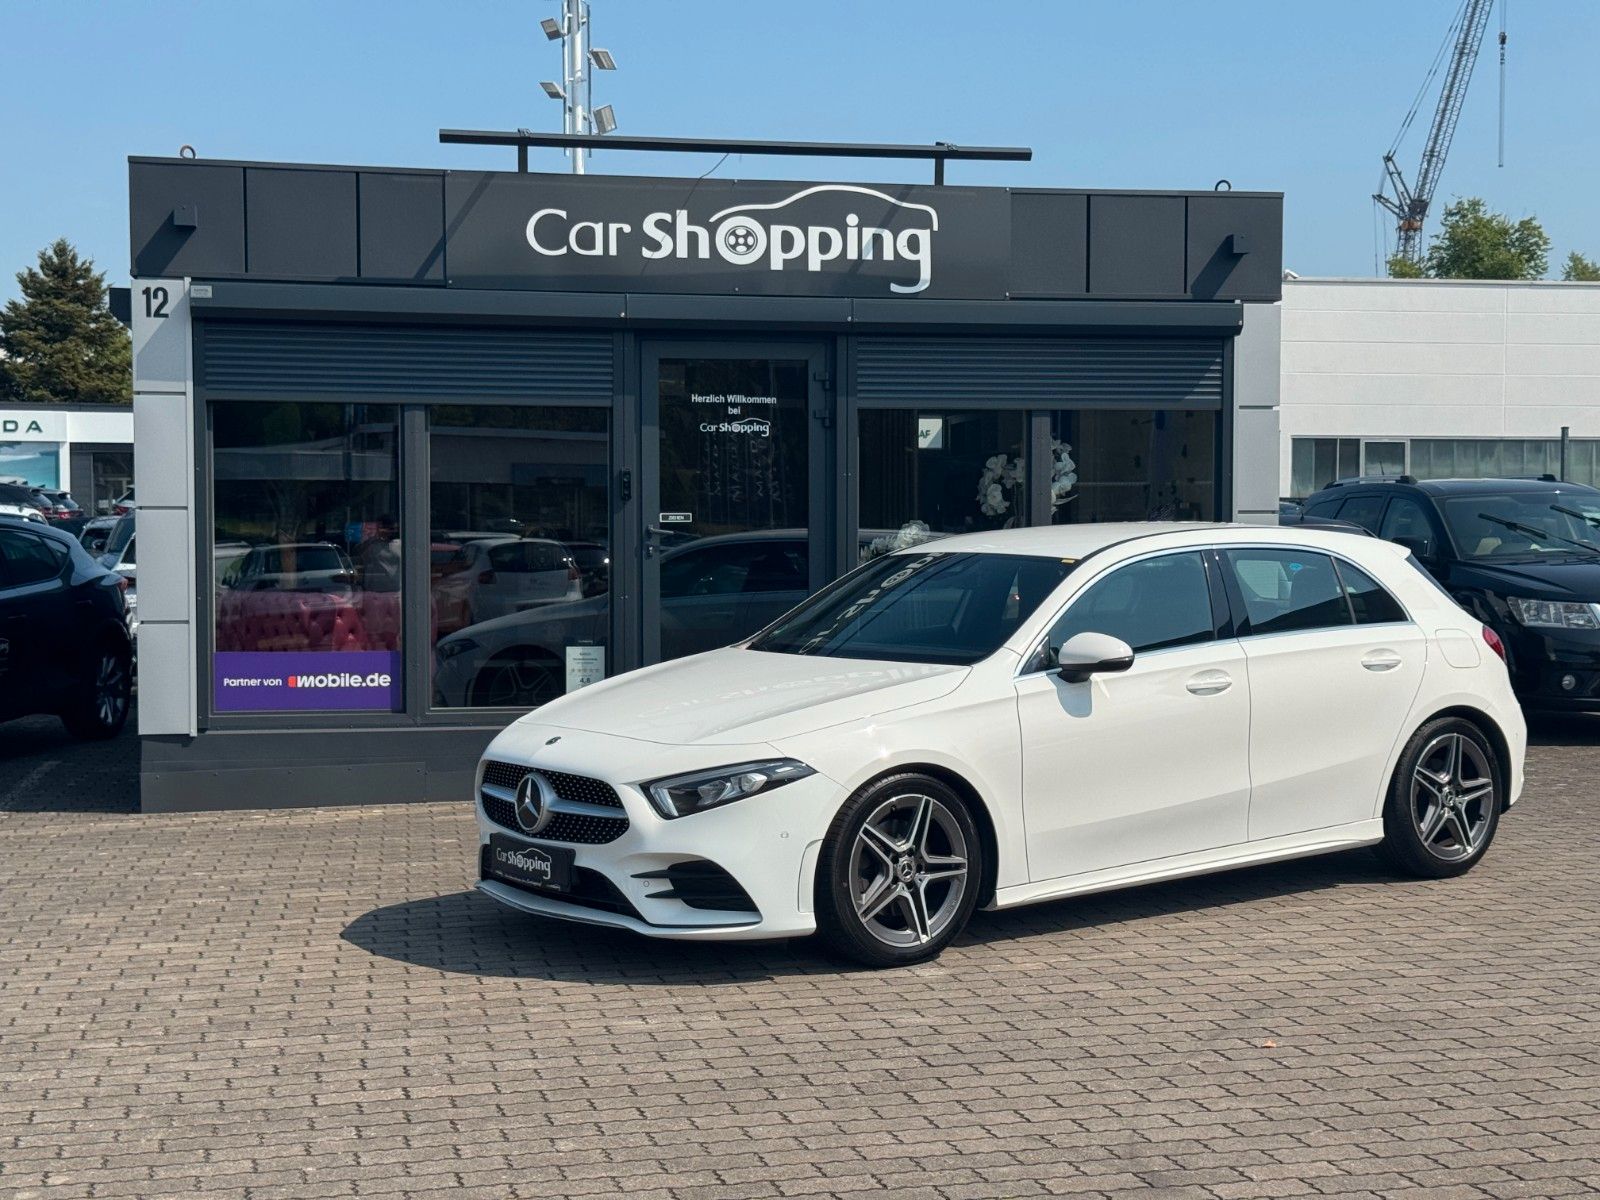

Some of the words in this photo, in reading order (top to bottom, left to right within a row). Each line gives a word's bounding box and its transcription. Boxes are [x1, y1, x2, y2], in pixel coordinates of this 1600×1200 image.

[526, 208, 631, 256] Car
[642, 208, 932, 294] Shopping
[142, 287, 169, 318] 12
[691, 394, 725, 403] Herzlich
[727, 395, 777, 404] Willkommen
[728, 406, 741, 415] bei
[700, 423, 717, 432] Car
[719, 422, 769, 437] Shopping
[223, 678, 261, 687] Partner
[296, 673, 391, 688] mobile.de
[496, 847, 508, 862] Car
[508, 850, 551, 880] Shopping
